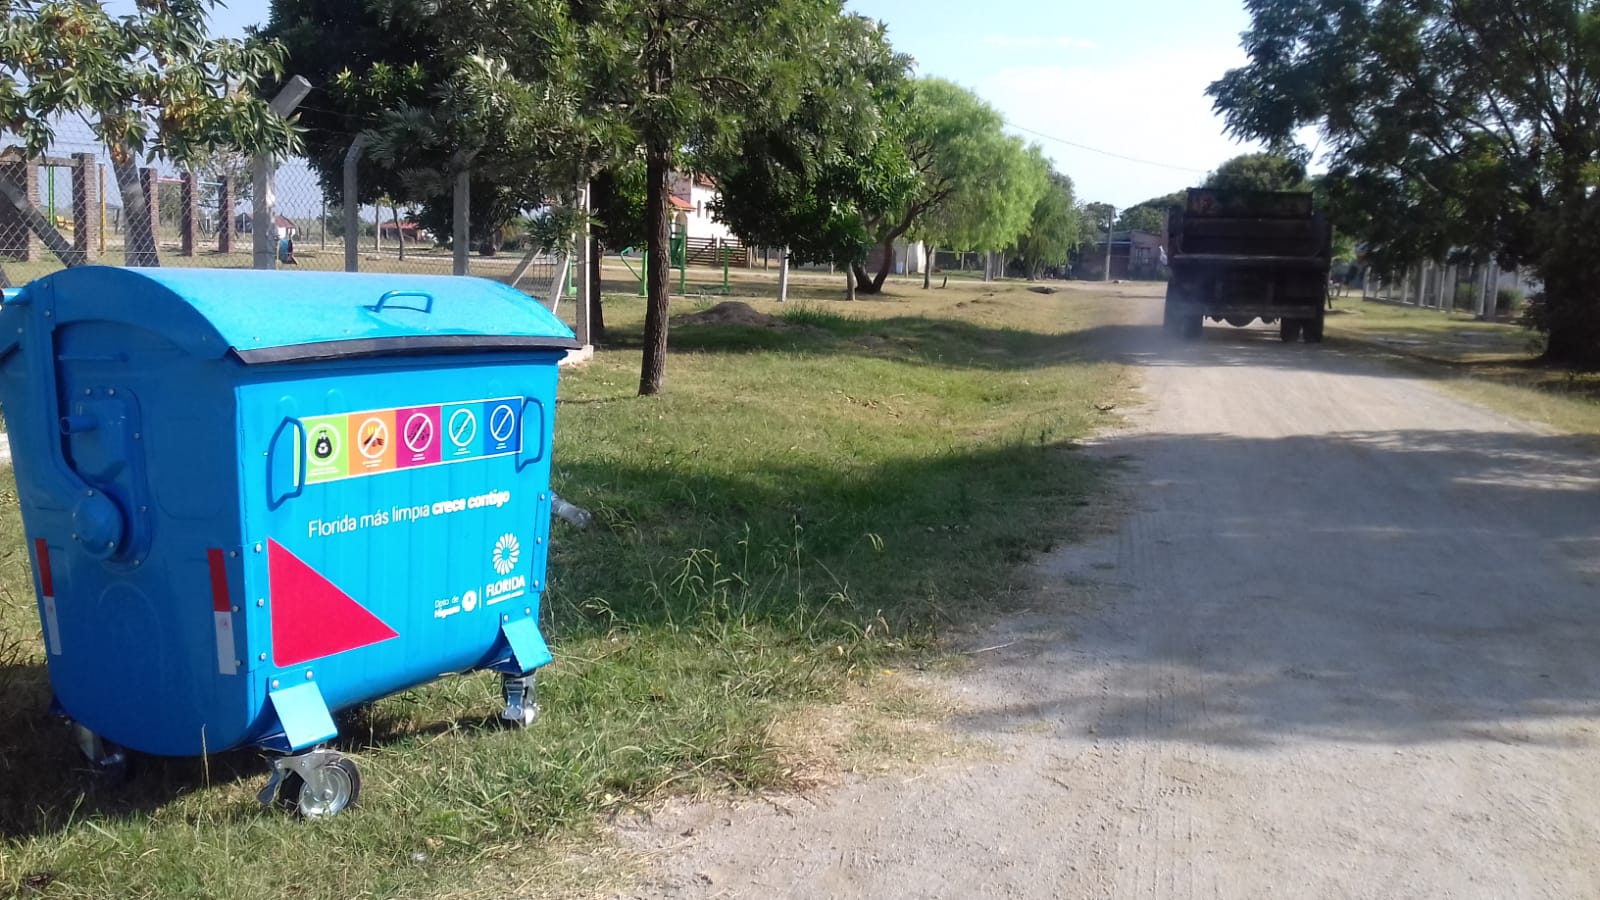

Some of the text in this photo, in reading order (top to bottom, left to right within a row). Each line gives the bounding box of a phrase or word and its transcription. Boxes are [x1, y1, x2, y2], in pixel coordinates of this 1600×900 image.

[308, 489, 510, 538] Florida más limpia crece contigo
[486, 575, 526, 598] FLORIDA
